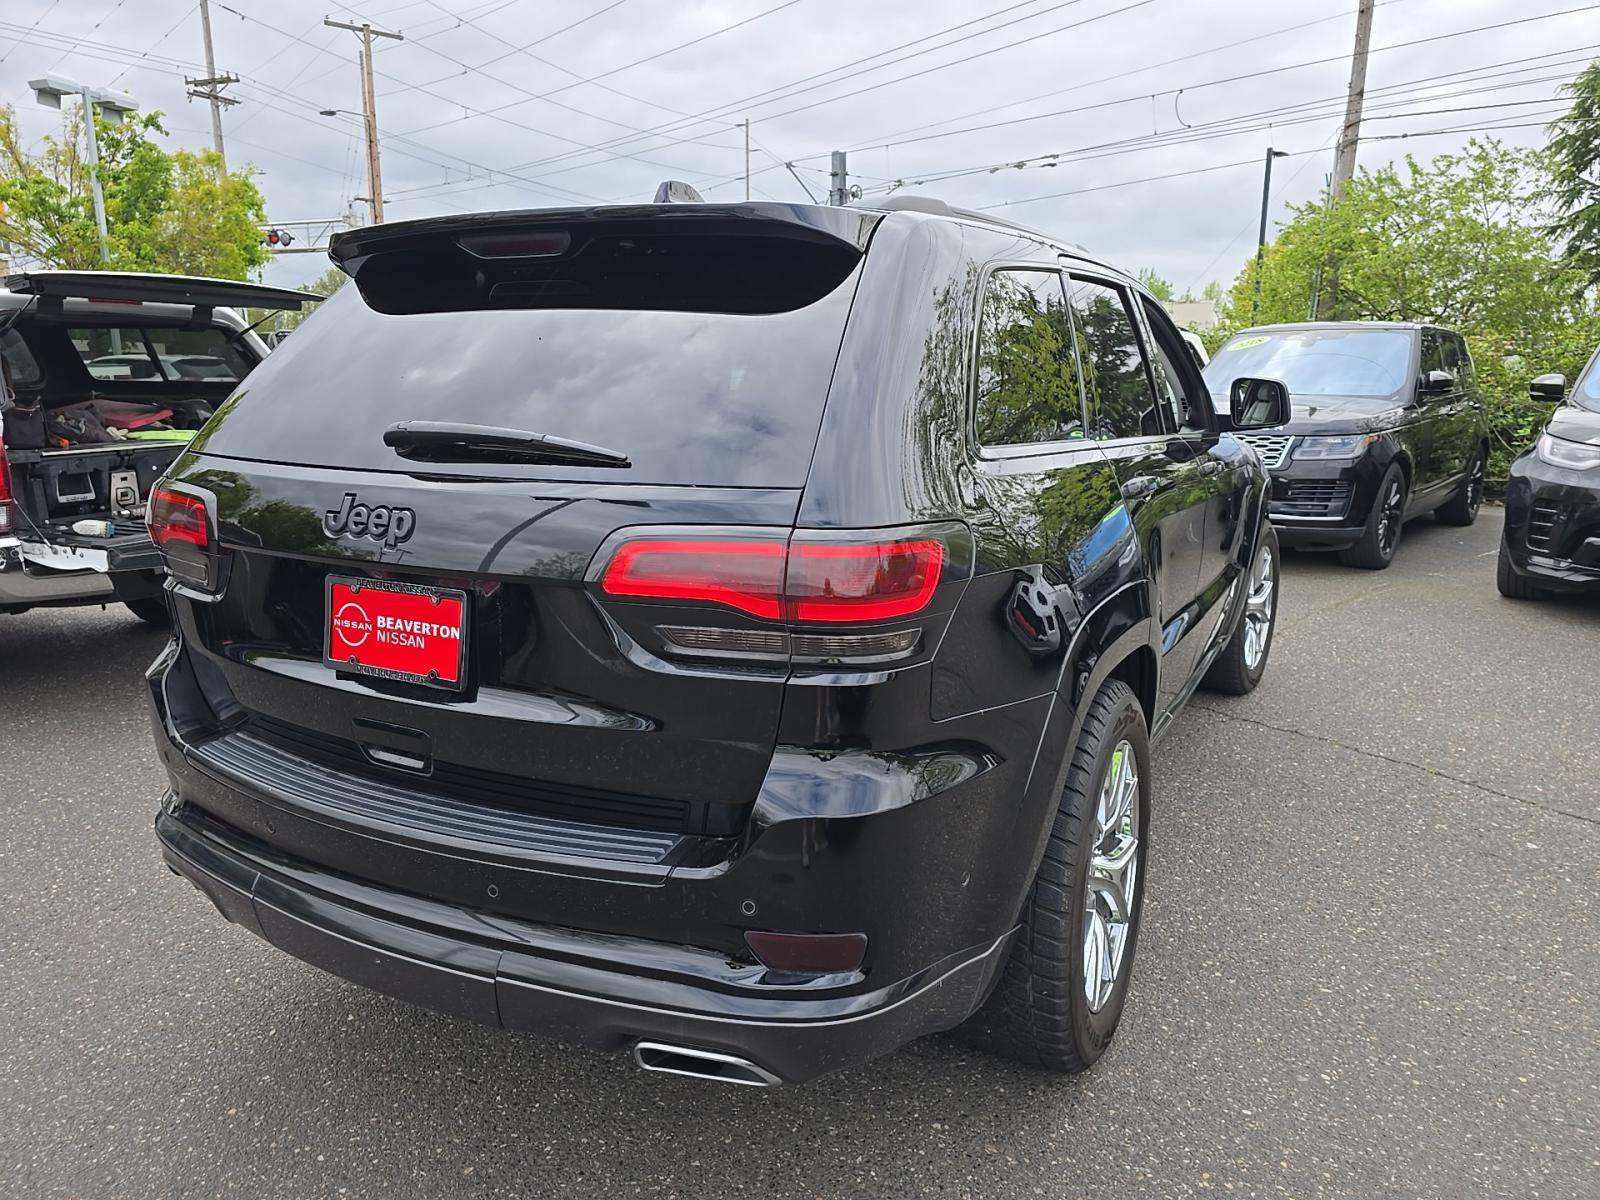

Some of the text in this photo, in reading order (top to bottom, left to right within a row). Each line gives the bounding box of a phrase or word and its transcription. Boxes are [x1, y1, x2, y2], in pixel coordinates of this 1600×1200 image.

[323, 493, 416, 551] Jeep
[334, 618, 372, 631] NISSAN
[377, 616, 459, 639] BEAVERTON
[377, 630, 425, 649] NISSAN
